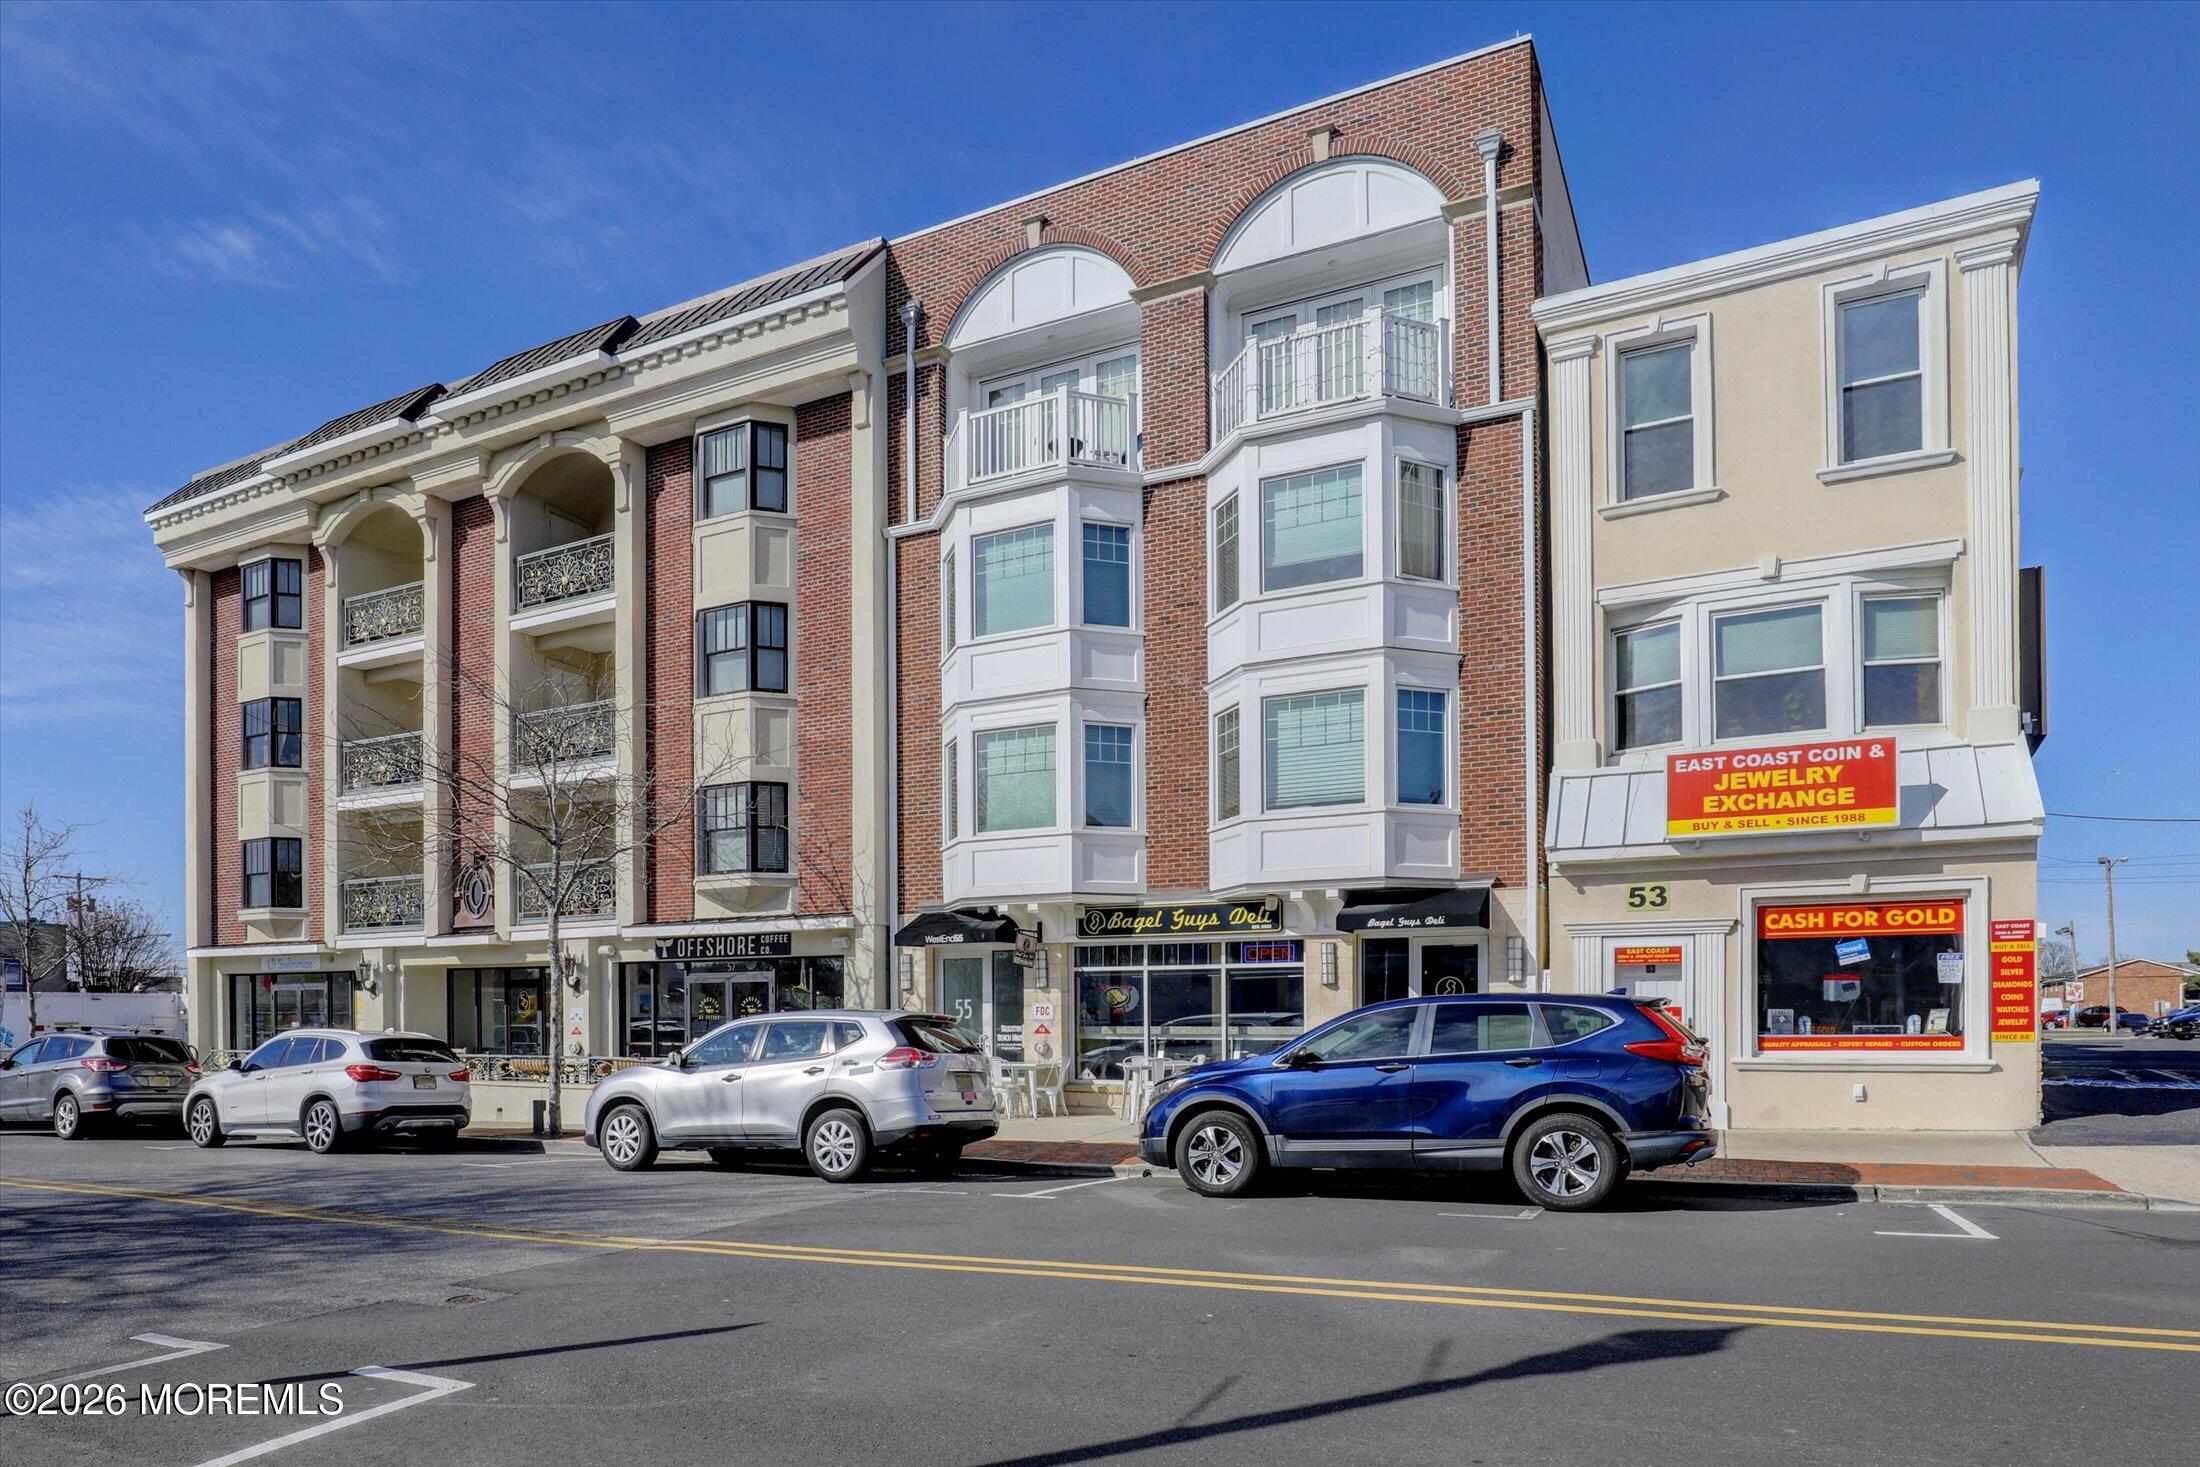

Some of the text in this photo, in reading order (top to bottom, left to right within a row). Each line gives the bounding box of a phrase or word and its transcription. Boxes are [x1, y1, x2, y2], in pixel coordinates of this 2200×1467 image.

[1675, 744, 1885, 773] EAST COAST COIN &
[1714, 765, 1843, 791] JEWELRY
[1703, 787, 1855, 813] EXCHANGE
[1692, 813, 1866, 831] BUY & SELL SINCE 1988
[1628, 886, 1668, 908] 53
[1107, 905, 1272, 933] Bagel Guys Deli
[1367, 916, 1445, 928] Bagel Guys Deli
[1765, 908, 1955, 929] CASH FOR GOLD
[677, 936, 756, 957] OFFSHORE
[760, 934, 788, 944] COFFEE
[925, 933, 964, 943] WestEnd55
[760, 946, 772, 955] CO.
[1247, 948, 1292, 960] OPEN
[1839, 943, 1863, 954] Closed
[726, 962, 736, 972] 57
[955, 999, 973, 1019] 55
[1035, 1006, 1050, 1016] FDC
